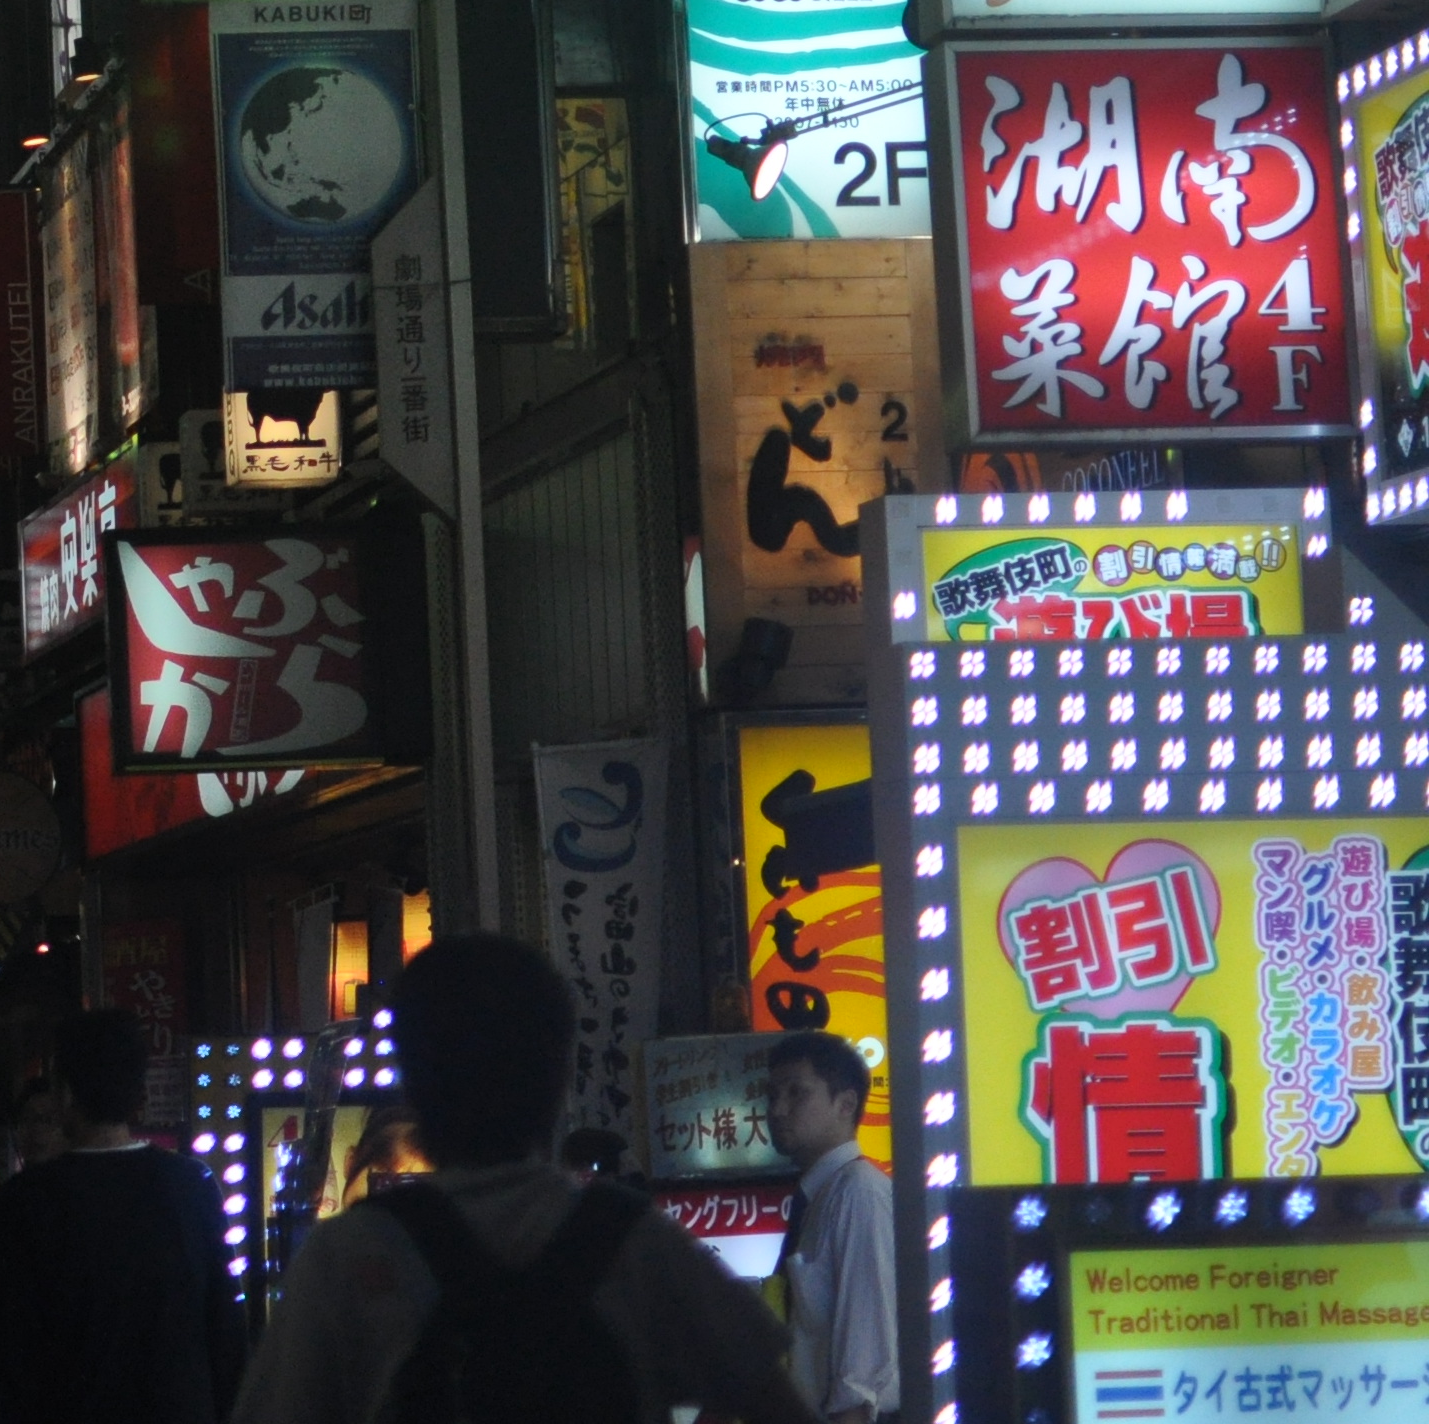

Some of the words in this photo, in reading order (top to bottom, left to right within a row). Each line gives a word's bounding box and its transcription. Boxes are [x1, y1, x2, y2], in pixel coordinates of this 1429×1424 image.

[834, 141, 929, 207] 2F
[980, 52, 1316, 248] 湖南
[393, 253, 430, 444] 劇場通り一番街
[991, 254, 1248, 420] 菜館
[1014, 870, 1211, 1006] 割引
[1085, 1268, 1200, 1295] Welcome
[1209, 1263, 1340, 1292] Foreigner
[1088, 1303, 1241, 1335] Traditional
[1251, 1300, 1308, 1329] Thai
[1319, 1301, 1429, 1330] Massage
[1173, 1363, 1429, 1416] タイ古式マッサー
